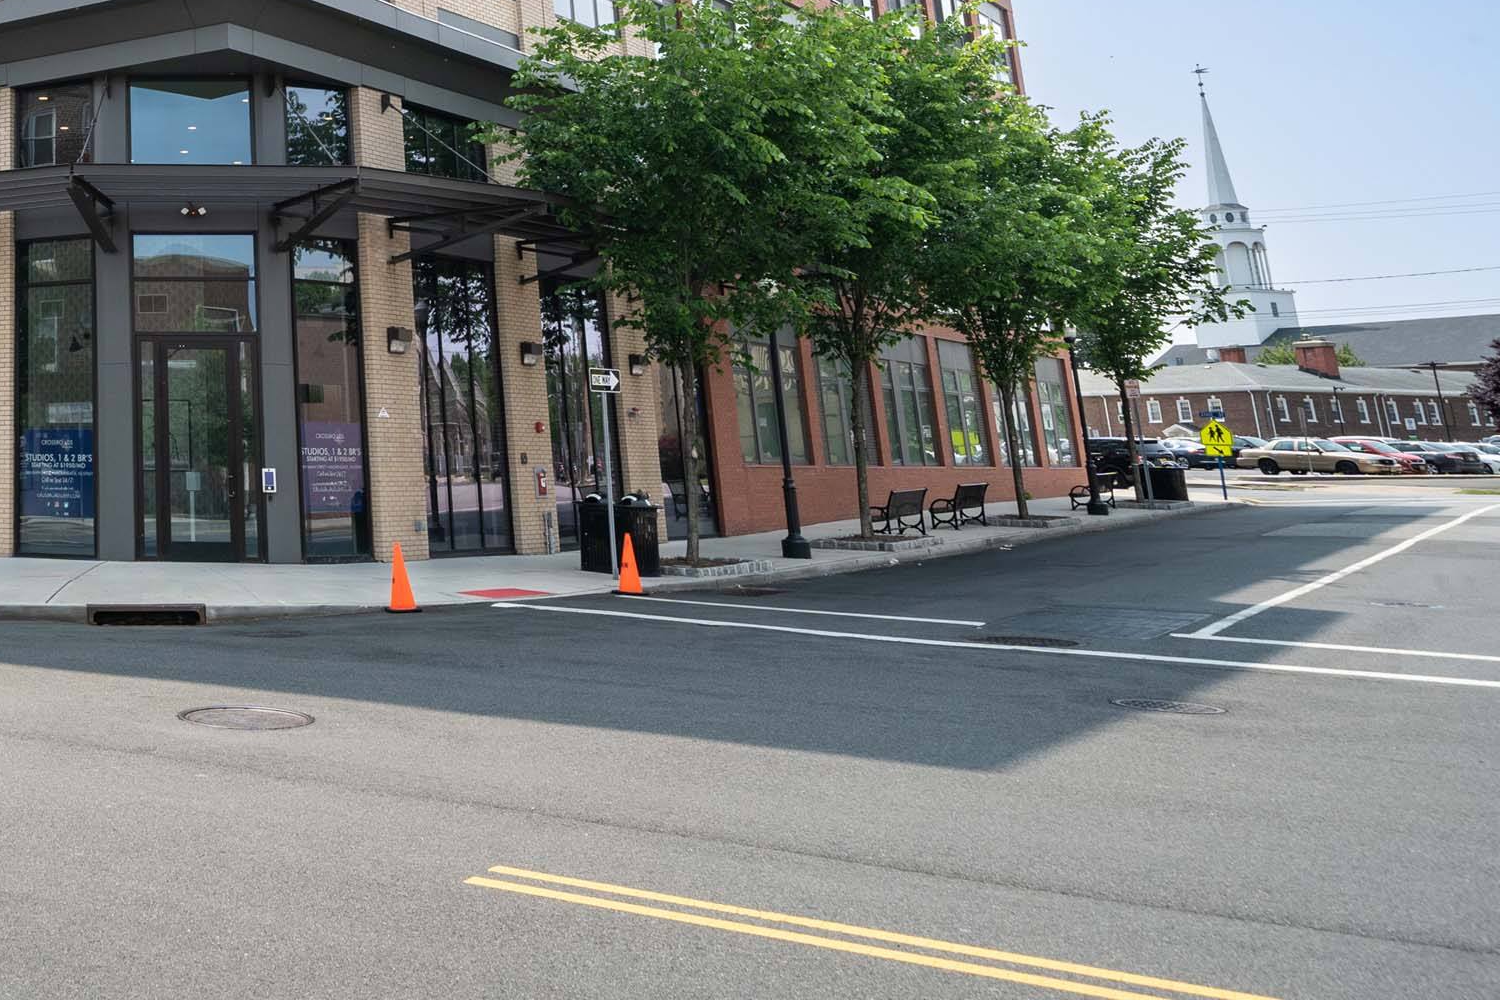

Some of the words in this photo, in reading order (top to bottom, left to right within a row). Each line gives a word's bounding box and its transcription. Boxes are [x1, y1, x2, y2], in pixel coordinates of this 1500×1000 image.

[593, 376, 601, 384] ONE
[602, 376, 611, 384] WAY
[63, 453, 69, 462] &
[70, 453, 76, 462] 2
